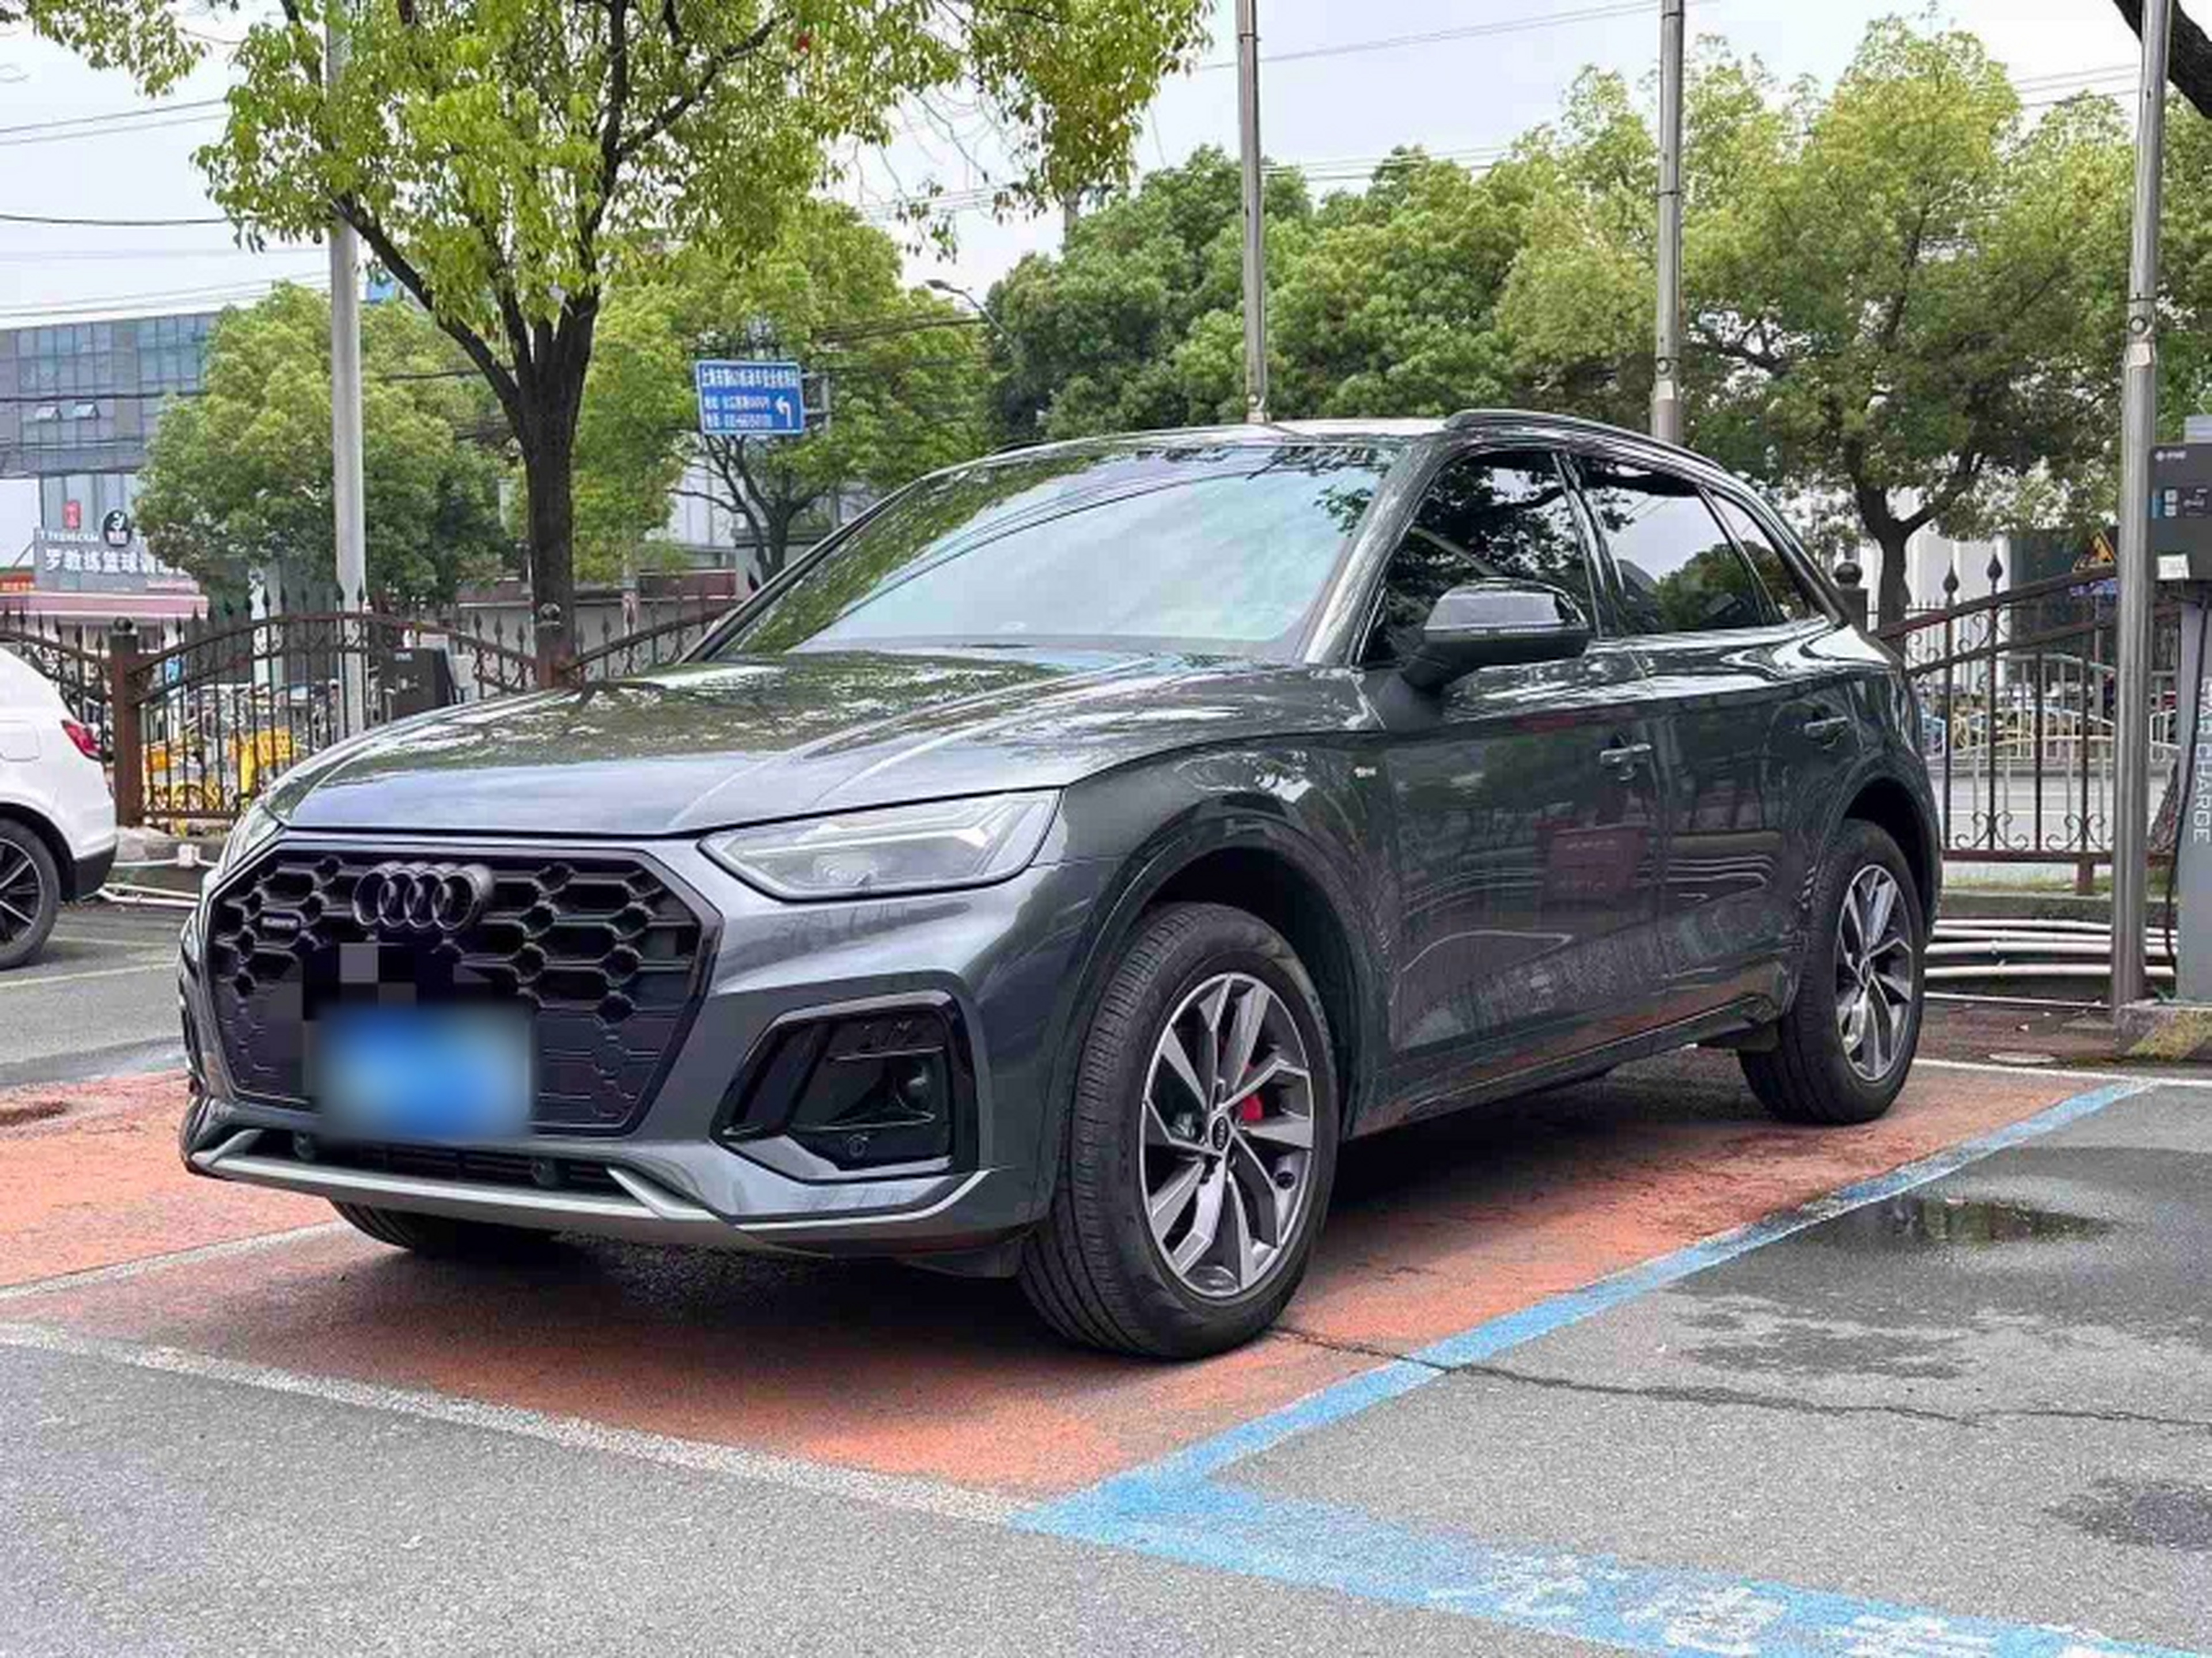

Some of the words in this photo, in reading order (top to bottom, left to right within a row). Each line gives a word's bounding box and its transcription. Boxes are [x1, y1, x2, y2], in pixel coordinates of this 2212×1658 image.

[46, 547, 194, 575] 罗教练篮球训
[2193, 743, 2211, 843] CHARGE
